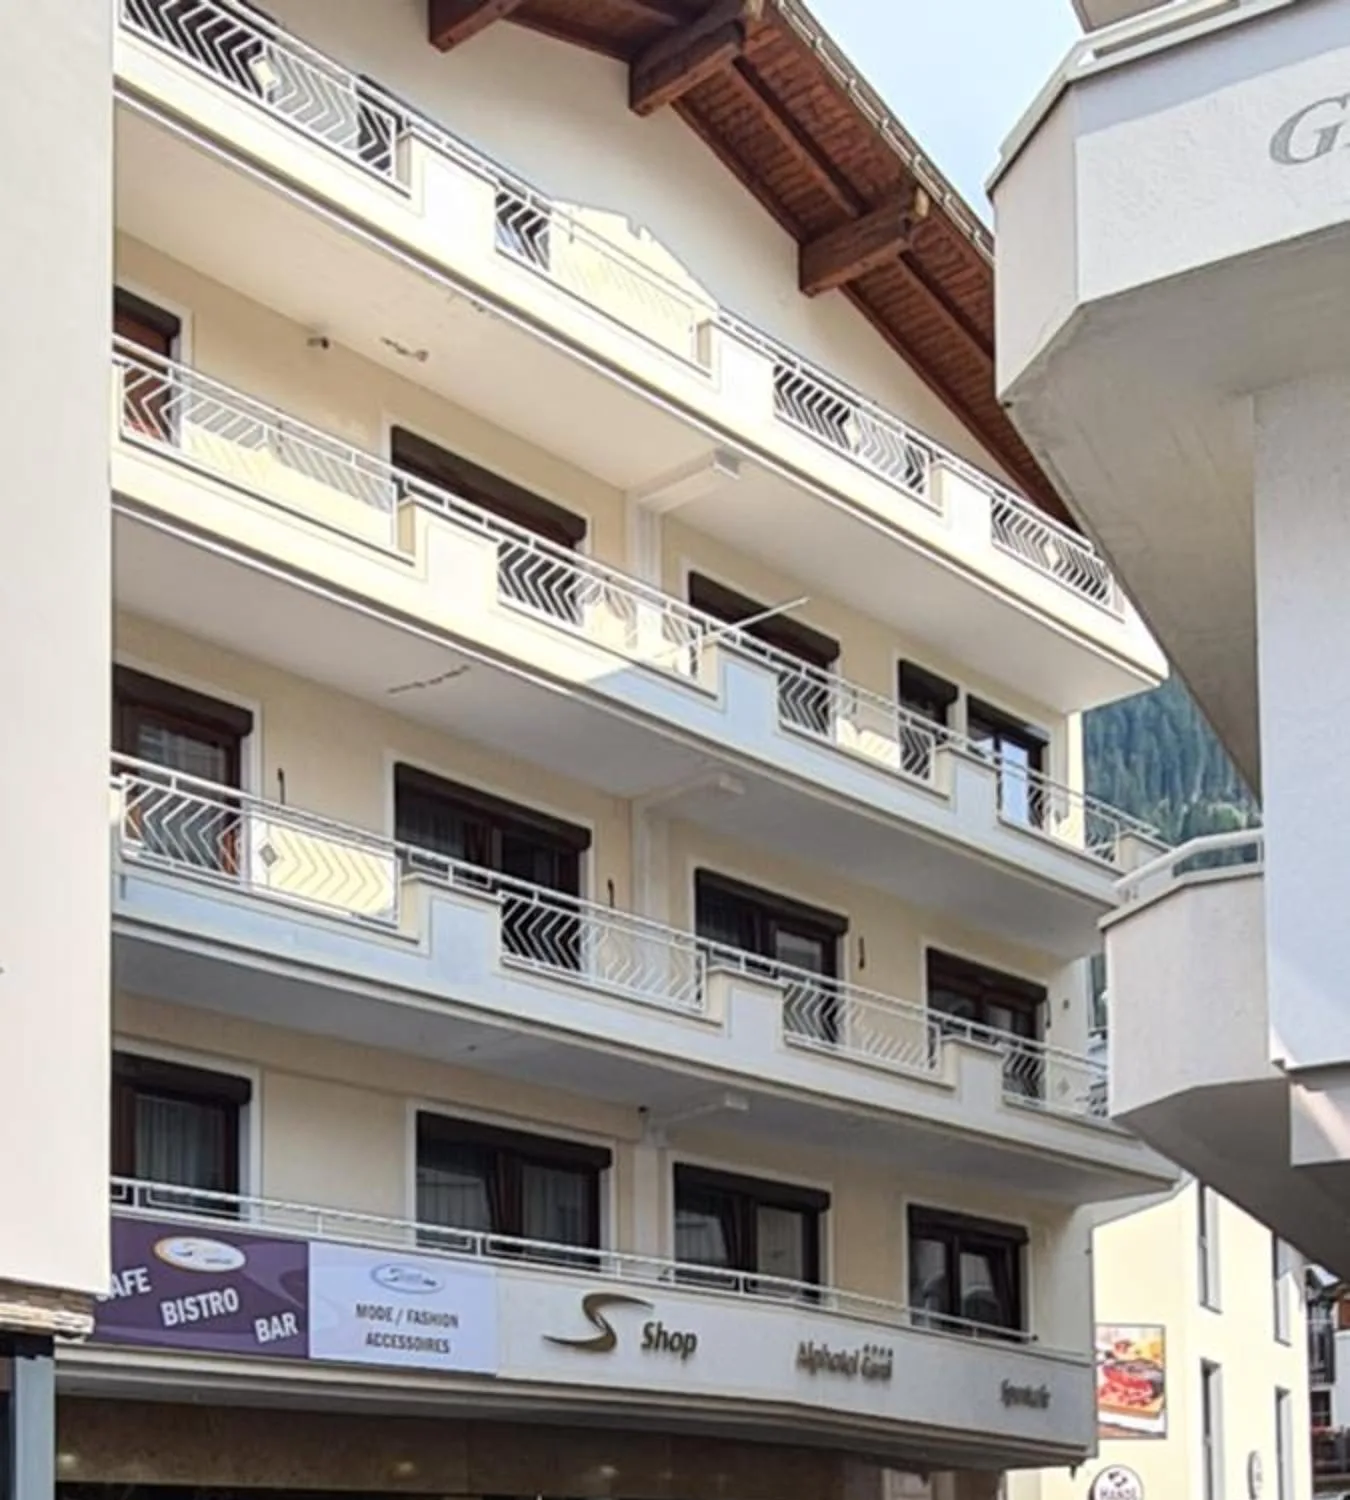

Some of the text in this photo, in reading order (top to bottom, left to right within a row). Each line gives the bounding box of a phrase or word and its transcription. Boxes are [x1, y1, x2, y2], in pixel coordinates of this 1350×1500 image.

[97, 1267, 151, 1302] AFE
[160, 1287, 239, 1327] BISTRO
[406, 1308, 459, 1329] FASHION
[255, 1312, 298, 1344] BAR
[641, 1321, 698, 1361] Shop
